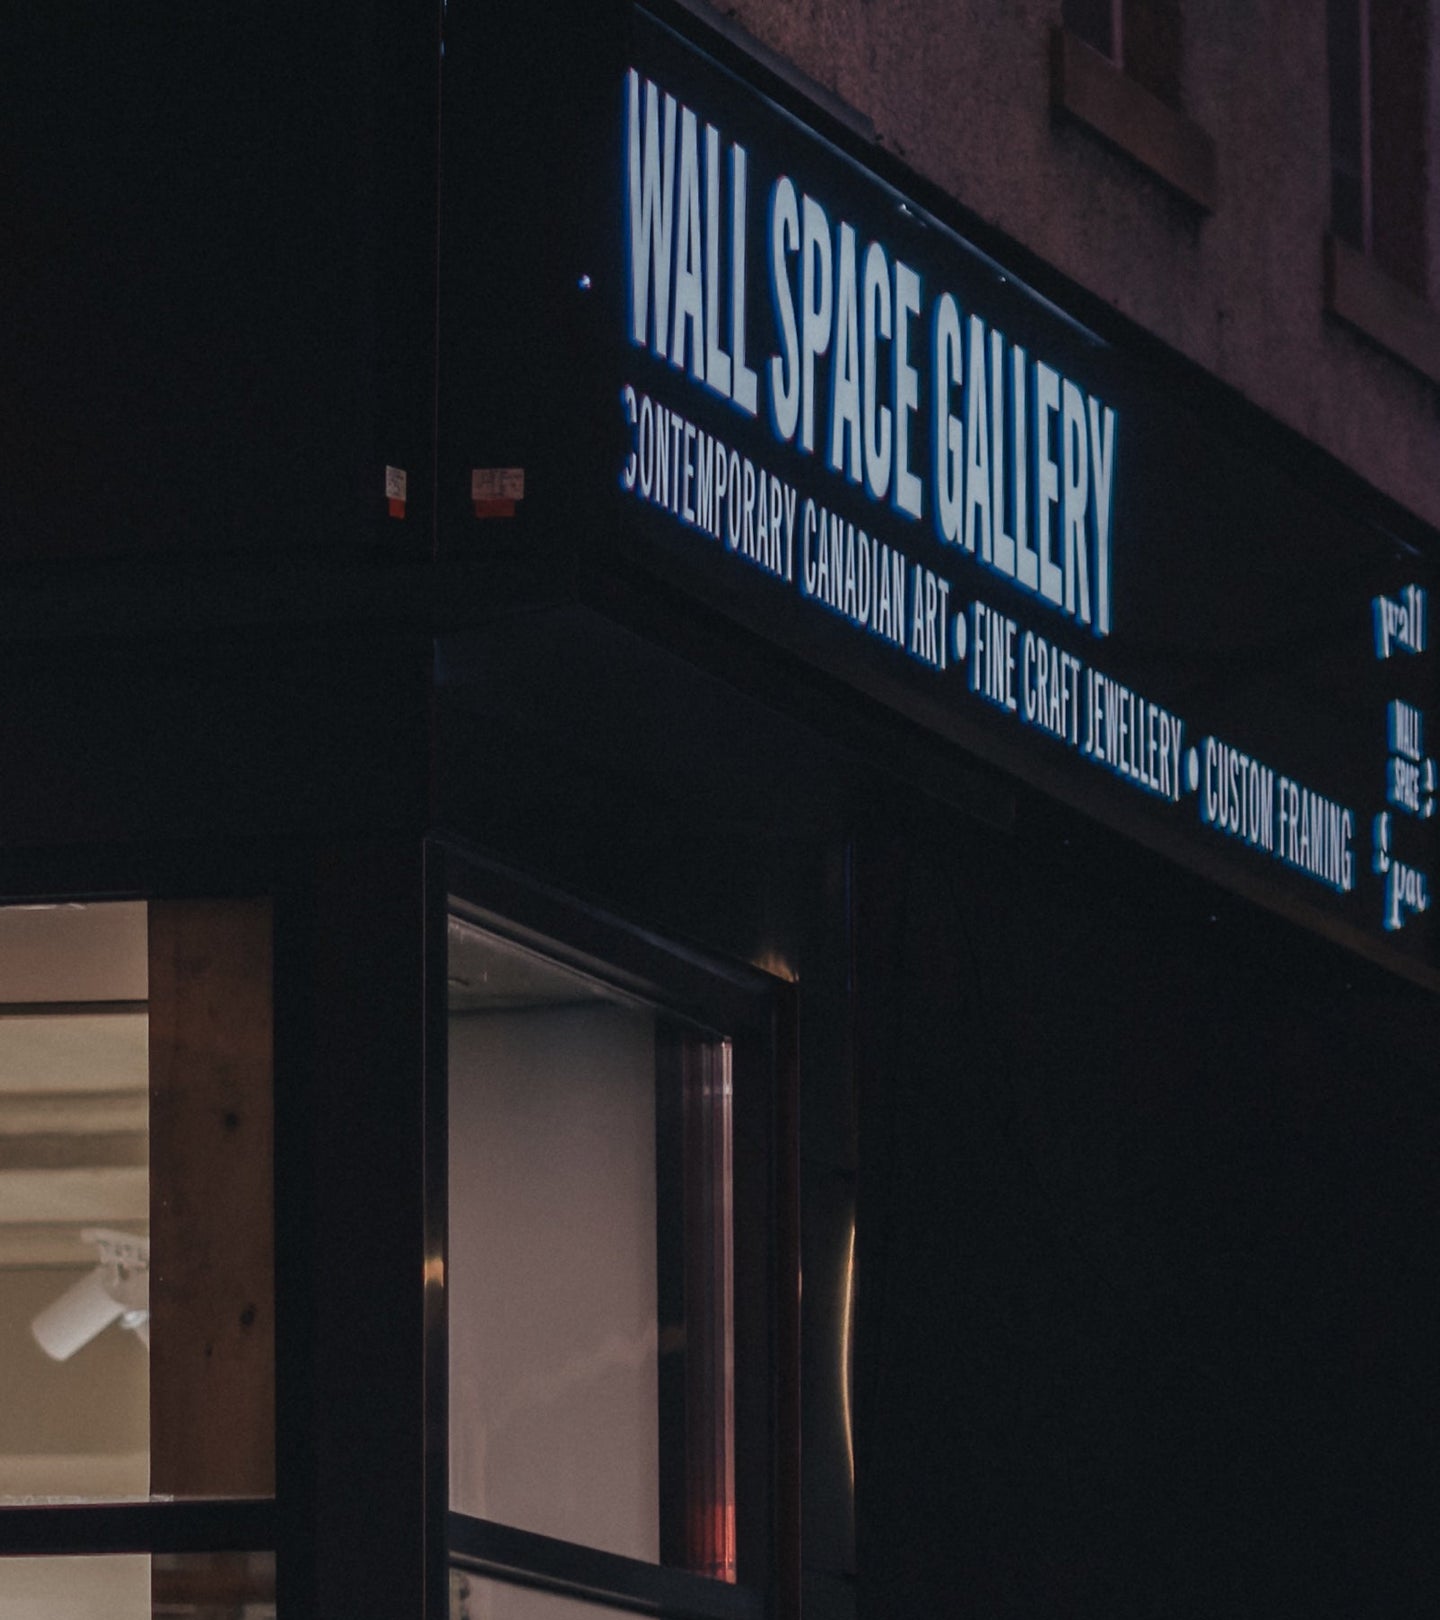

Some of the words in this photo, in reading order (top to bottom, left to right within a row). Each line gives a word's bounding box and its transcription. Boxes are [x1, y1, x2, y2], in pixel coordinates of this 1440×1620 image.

[629, 67, 758, 415] WALL
[772, 176, 922, 519] SPACE
[937, 292, 1115, 635] GALLERY
[624, 384, 797, 583] CONTEMPORARY
[803, 497, 906, 647] CANADIAN
[911, 563, 950, 670] ART
[973, 600, 1018, 713] FINE
[1023, 630, 1080, 746] CRAFT
[1085, 667, 1182, 802] JEWELLERY
[1204, 735, 1275, 852] CUSTOM
[1278, 776, 1353, 892] FRAMING
[1394, 698, 1421, 761] WALL
[1393, 755, 1421, 812] SPACE
